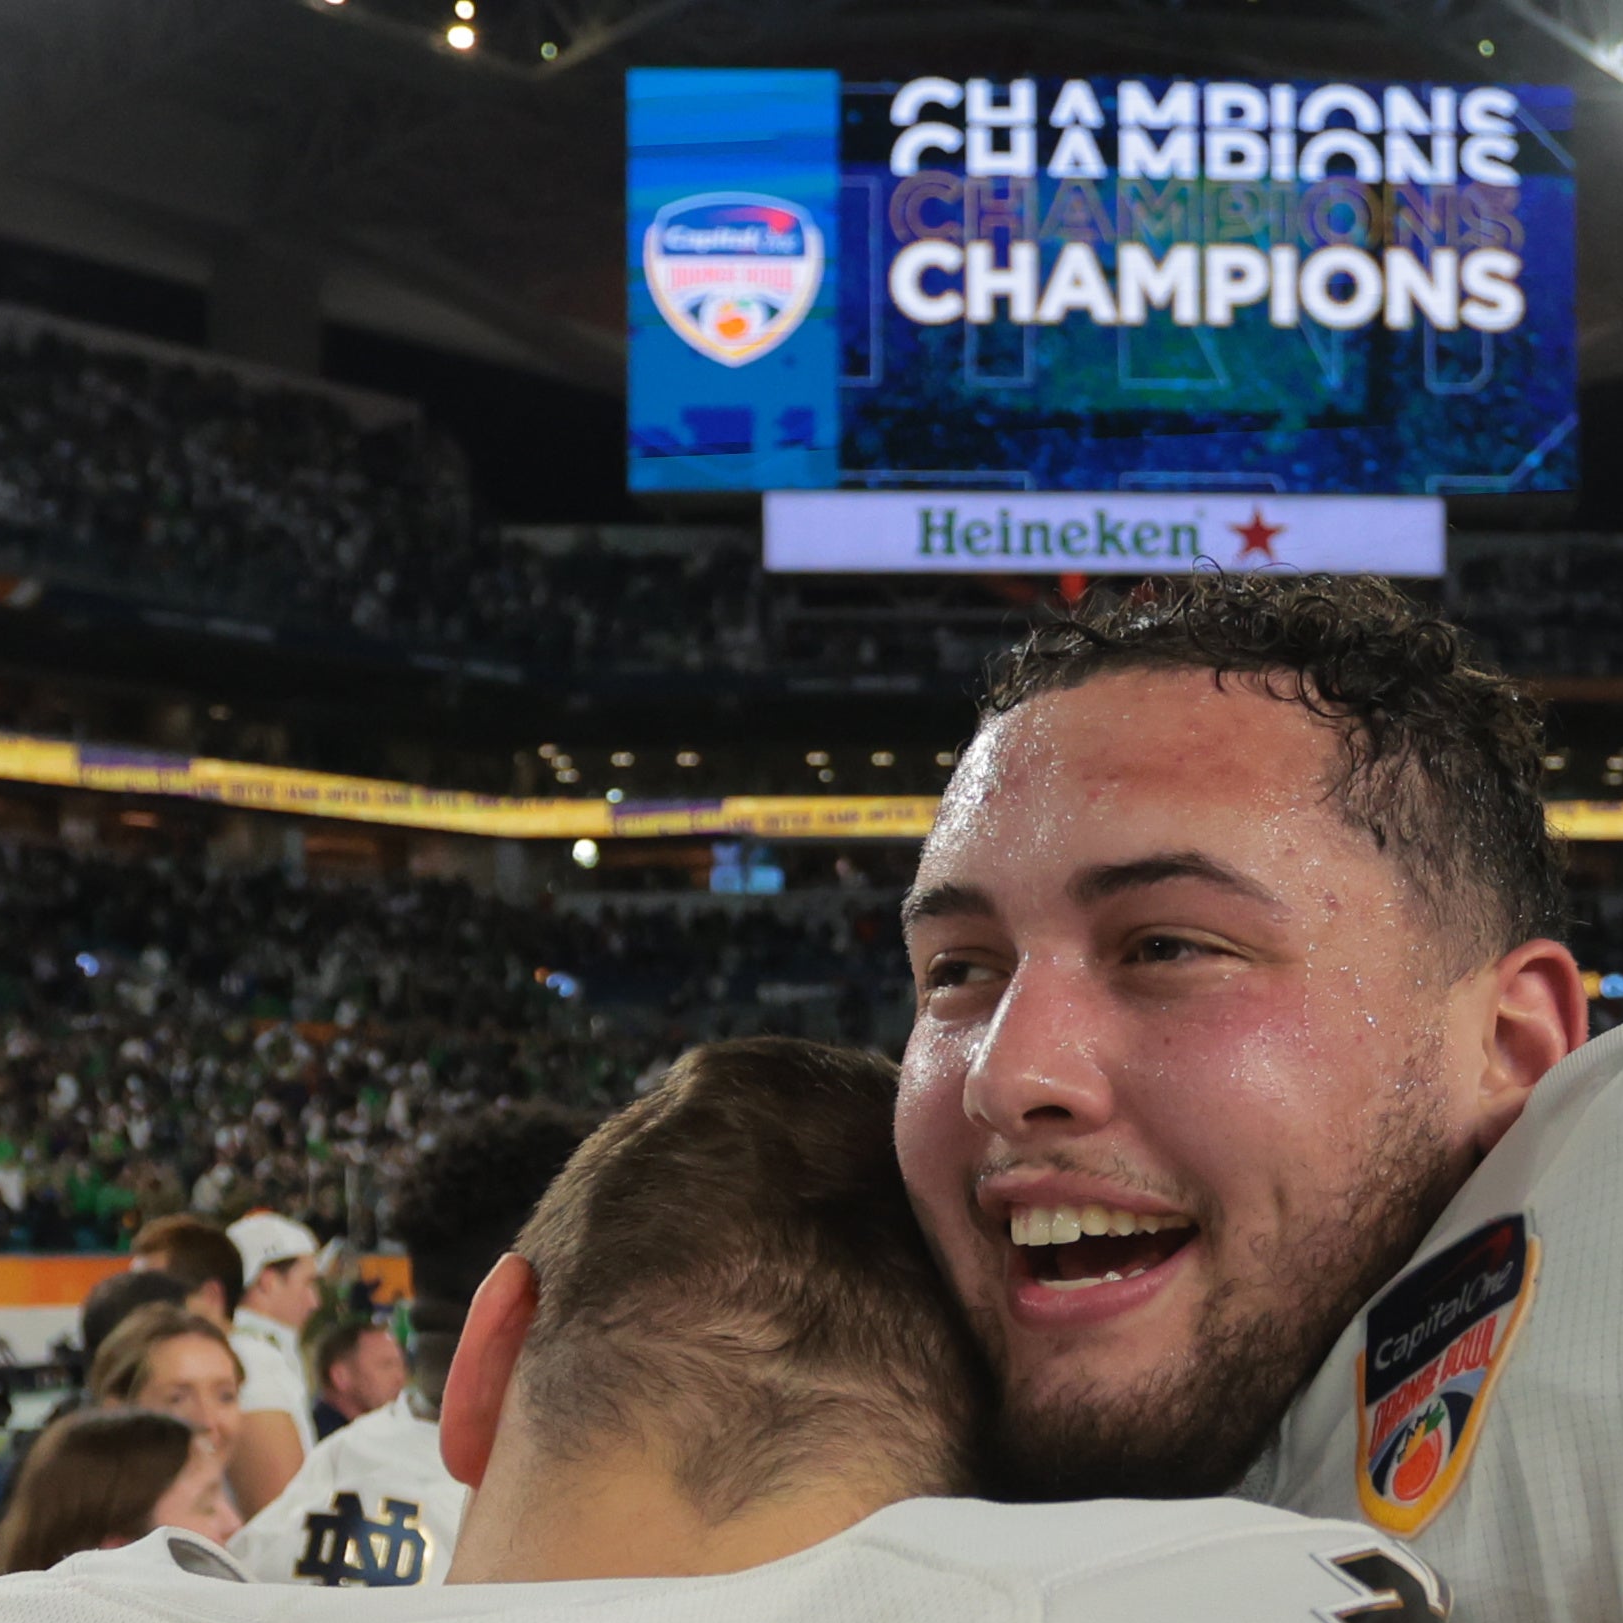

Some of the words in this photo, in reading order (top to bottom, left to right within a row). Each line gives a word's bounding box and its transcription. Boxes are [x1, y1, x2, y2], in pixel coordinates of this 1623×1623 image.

[889, 75, 1520, 137] CHAMPIONS
[889, 121, 1522, 187] CHAMPIONS
[887, 238, 1526, 332] CHAMPIONS
[917, 505, 1202, 558] Heineken
